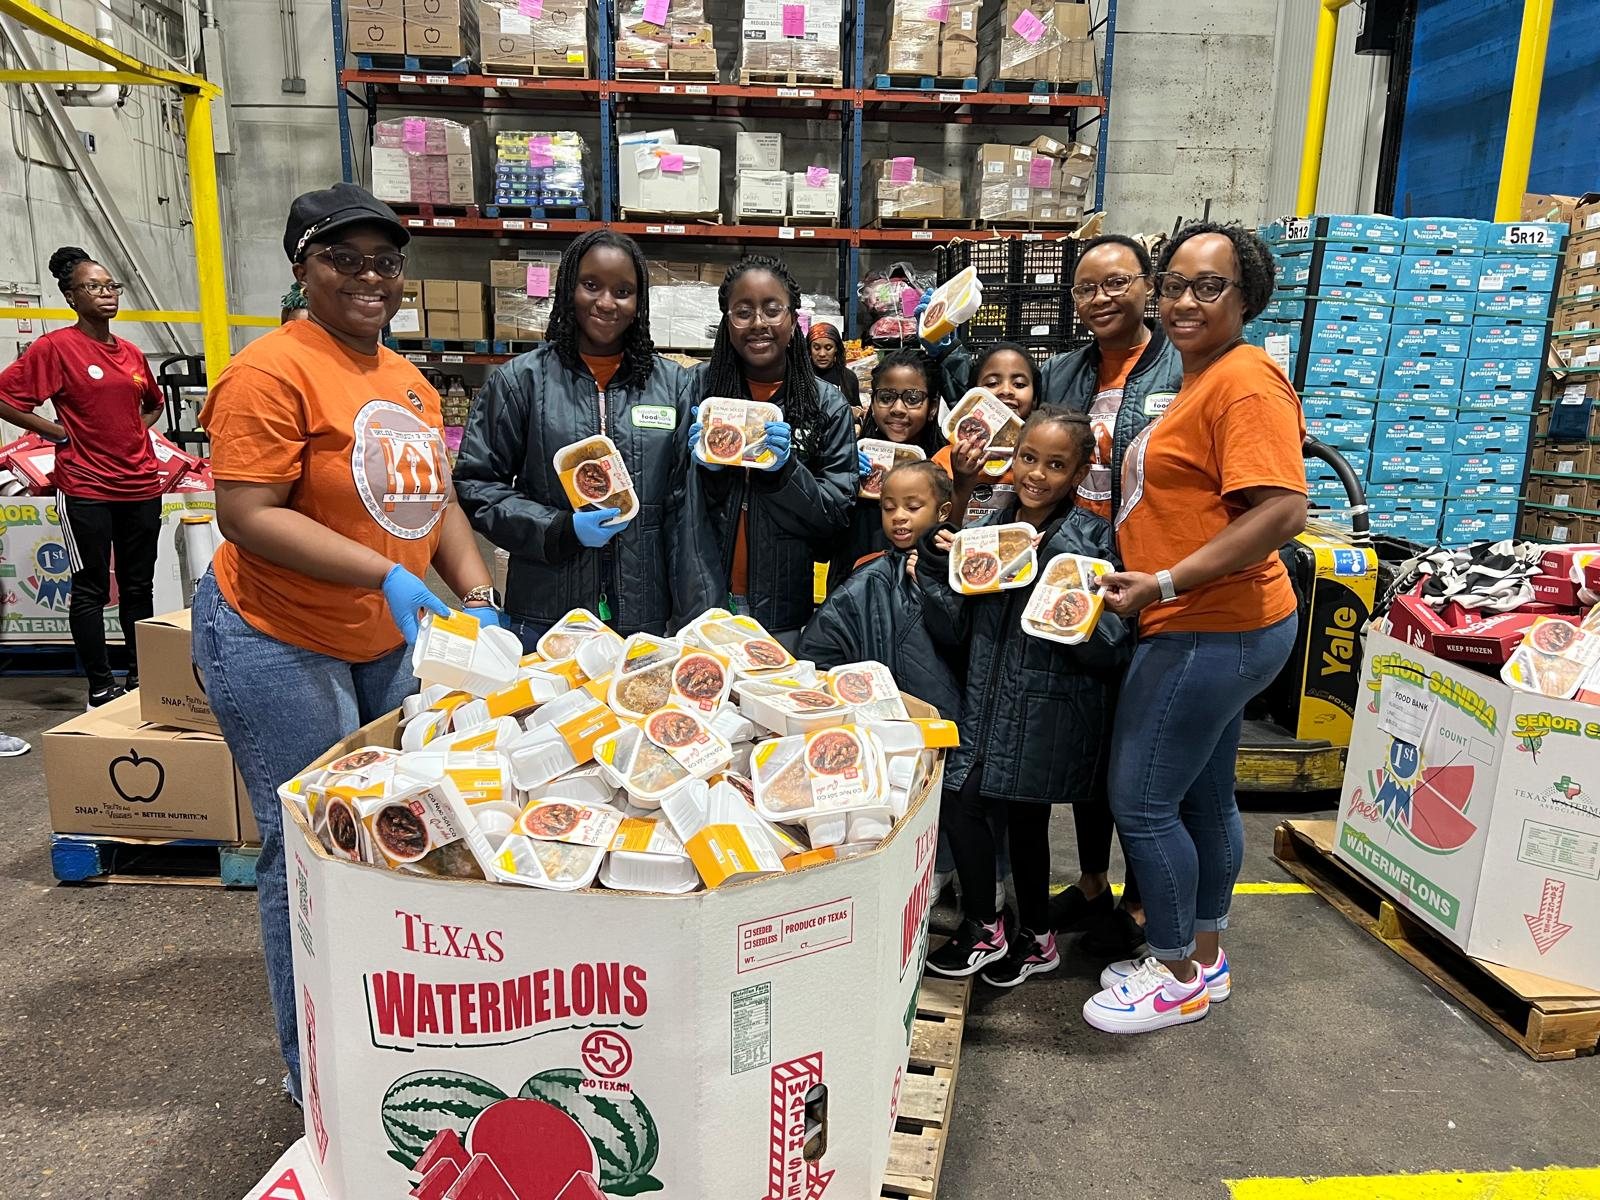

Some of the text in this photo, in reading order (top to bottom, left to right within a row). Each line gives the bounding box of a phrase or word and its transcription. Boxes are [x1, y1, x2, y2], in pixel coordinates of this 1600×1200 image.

[1288, 222, 1308, 239] 5R12
[1510, 227, 1544, 244] 5R12
[42, 550, 64, 568] 1st
[1322, 606, 1357, 676] Yale
[1466, 646, 1493, 654] FROZEN
[1371, 652, 1424, 683] SEÑOR
[162, 696, 182, 707] SNAP
[1395, 691, 1411, 704] FOOD
[1412, 698, 1428, 711] BANK
[1516, 712, 1578, 732] SEÑOR
[1439, 726, 1468, 748] COUNT
[1391, 742, 1415, 770] 1st
[1348, 786, 1380, 822] Joe's
[1514, 788, 1548, 802] TEXAS
[74, 806, 98, 814] SNAP
[1346, 834, 1452, 918] WATERMELONS
[1546, 886, 1559, 913] WATCH
[752, 924, 772, 937] SEEDED
[785, 910, 848, 935] PRODUCE OF TEXAS
[395, 910, 504, 963] TEXAS
[752, 934, 778, 948] SEEDLESS
[744, 956, 756, 964] WT.
[372, 962, 648, 1038] WATERMELONS
[582, 1078, 631, 1093] GO TEXAN
[786, 1081, 810, 1152] WATCH
[786, 1157, 802, 1200] STE
